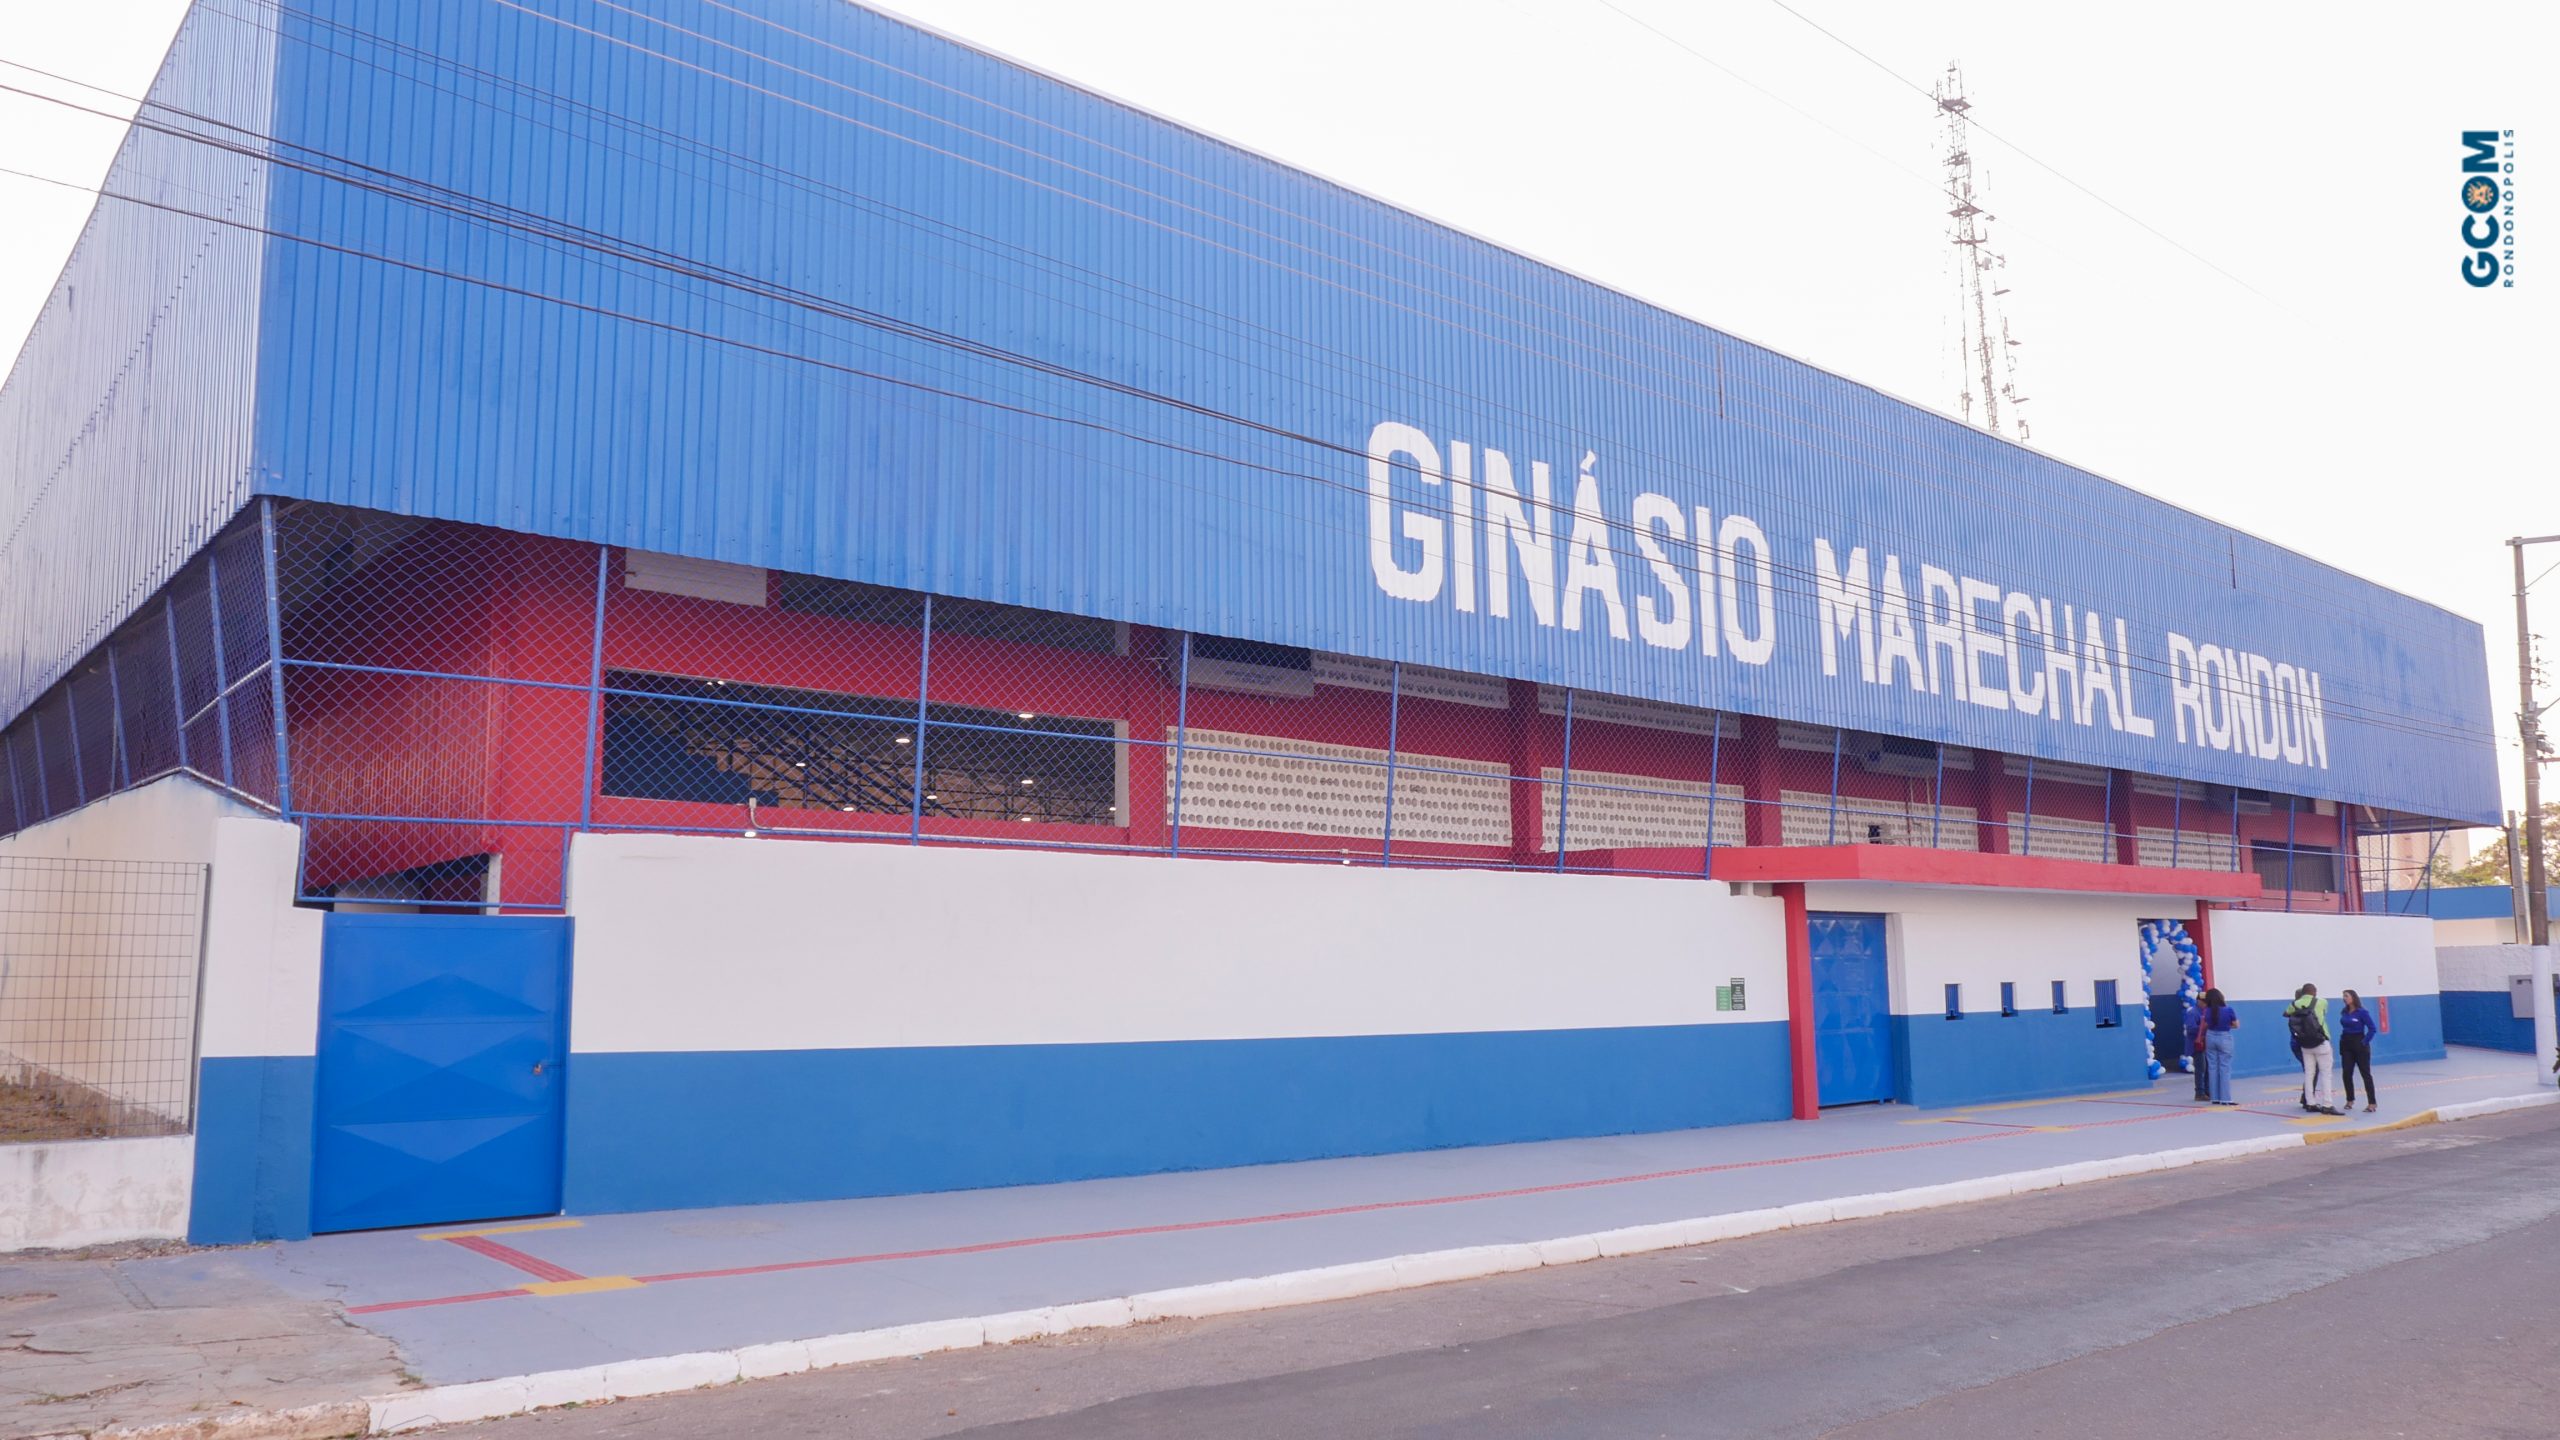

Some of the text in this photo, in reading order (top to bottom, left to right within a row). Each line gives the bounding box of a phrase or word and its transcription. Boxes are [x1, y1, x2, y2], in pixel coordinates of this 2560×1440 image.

[1368, 421, 2329, 770] GINÁSIO MARECHAL RONDON
